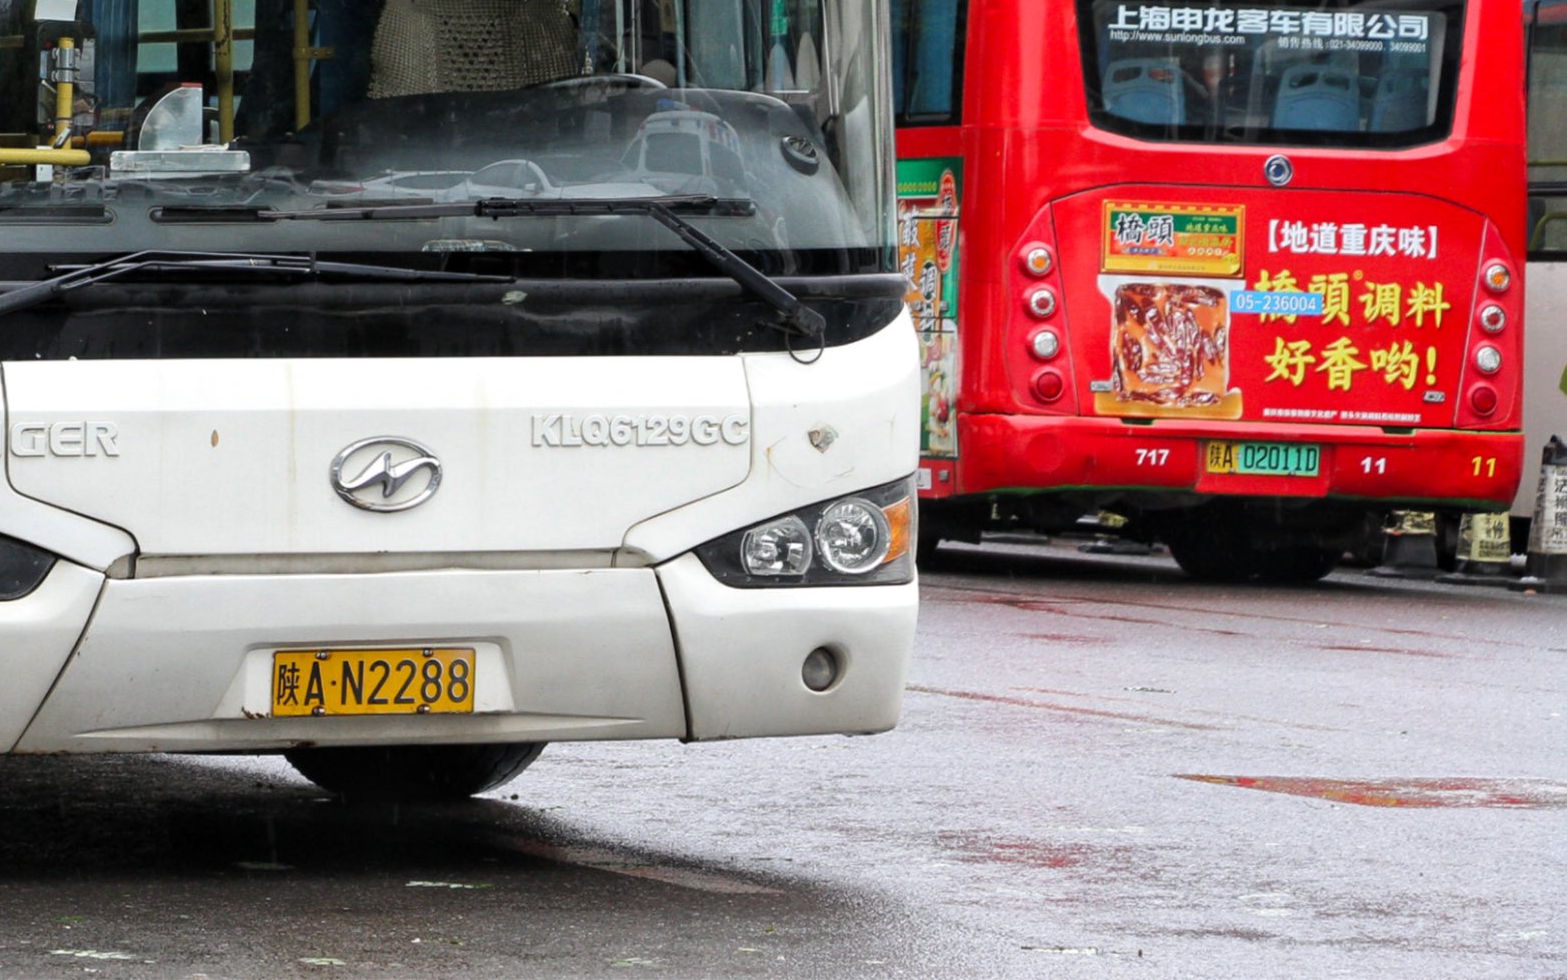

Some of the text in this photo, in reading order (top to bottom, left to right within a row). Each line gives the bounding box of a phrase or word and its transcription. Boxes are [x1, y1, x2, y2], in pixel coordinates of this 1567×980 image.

[1108, 4, 1429, 41] 上海申龙客车有限公司
[1110, 30, 1245, 45] http://www.sunlongbus.com
[1236, 293, 1317, 312] 05-236004
[530, 413, 749, 449] KLQ6129GC
[1135, 448, 1170, 466] 717
[1360, 456, 1387, 474] 11
[1471, 456, 1497, 477] 11
